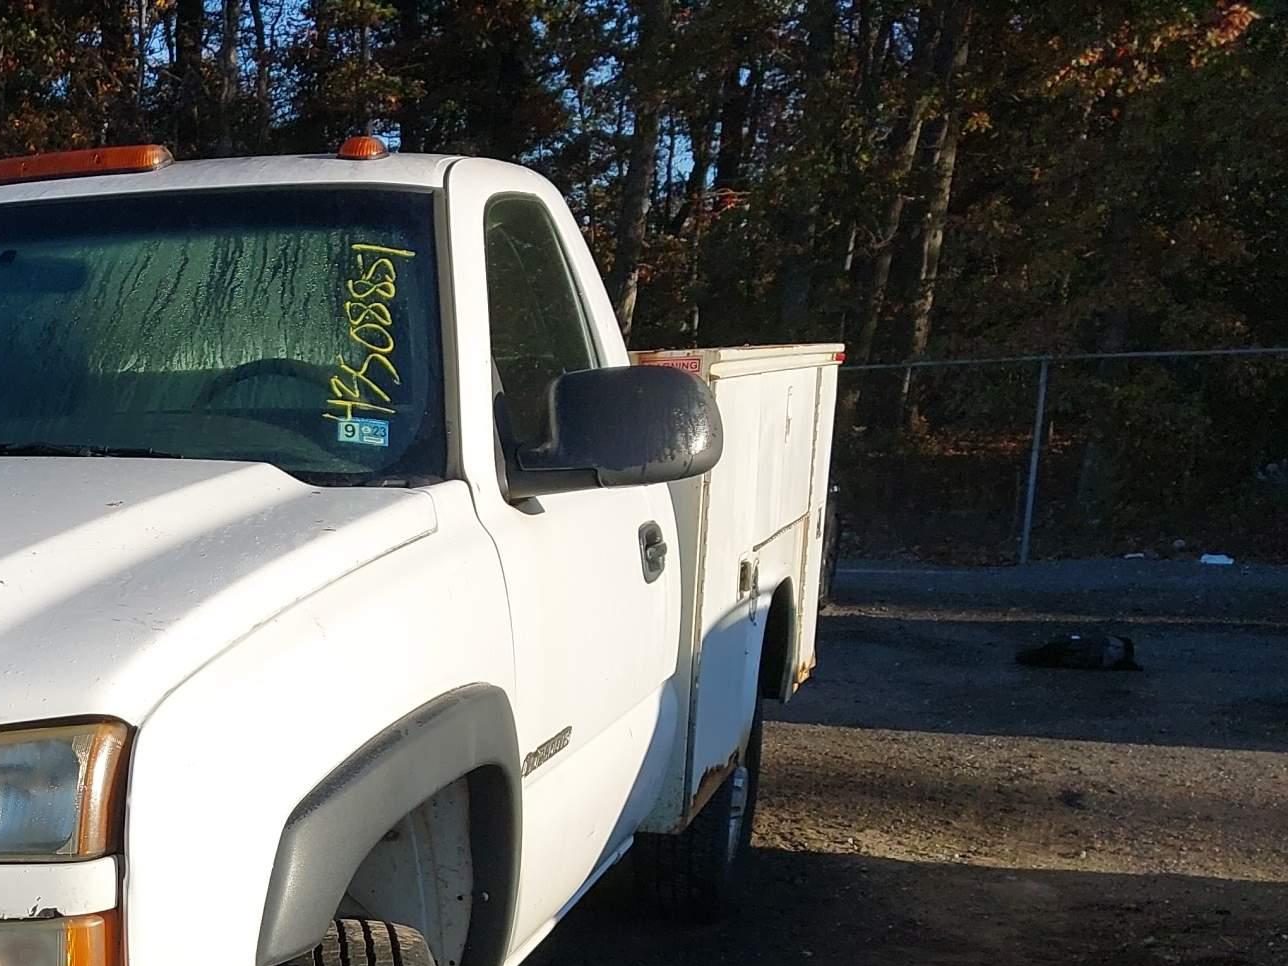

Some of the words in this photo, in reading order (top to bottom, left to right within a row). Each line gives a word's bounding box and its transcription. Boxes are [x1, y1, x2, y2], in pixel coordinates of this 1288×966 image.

[322, 243, 416, 421] 43508851
[344, 423, 356, 438] 9
[372, 425, 387, 438] 23
